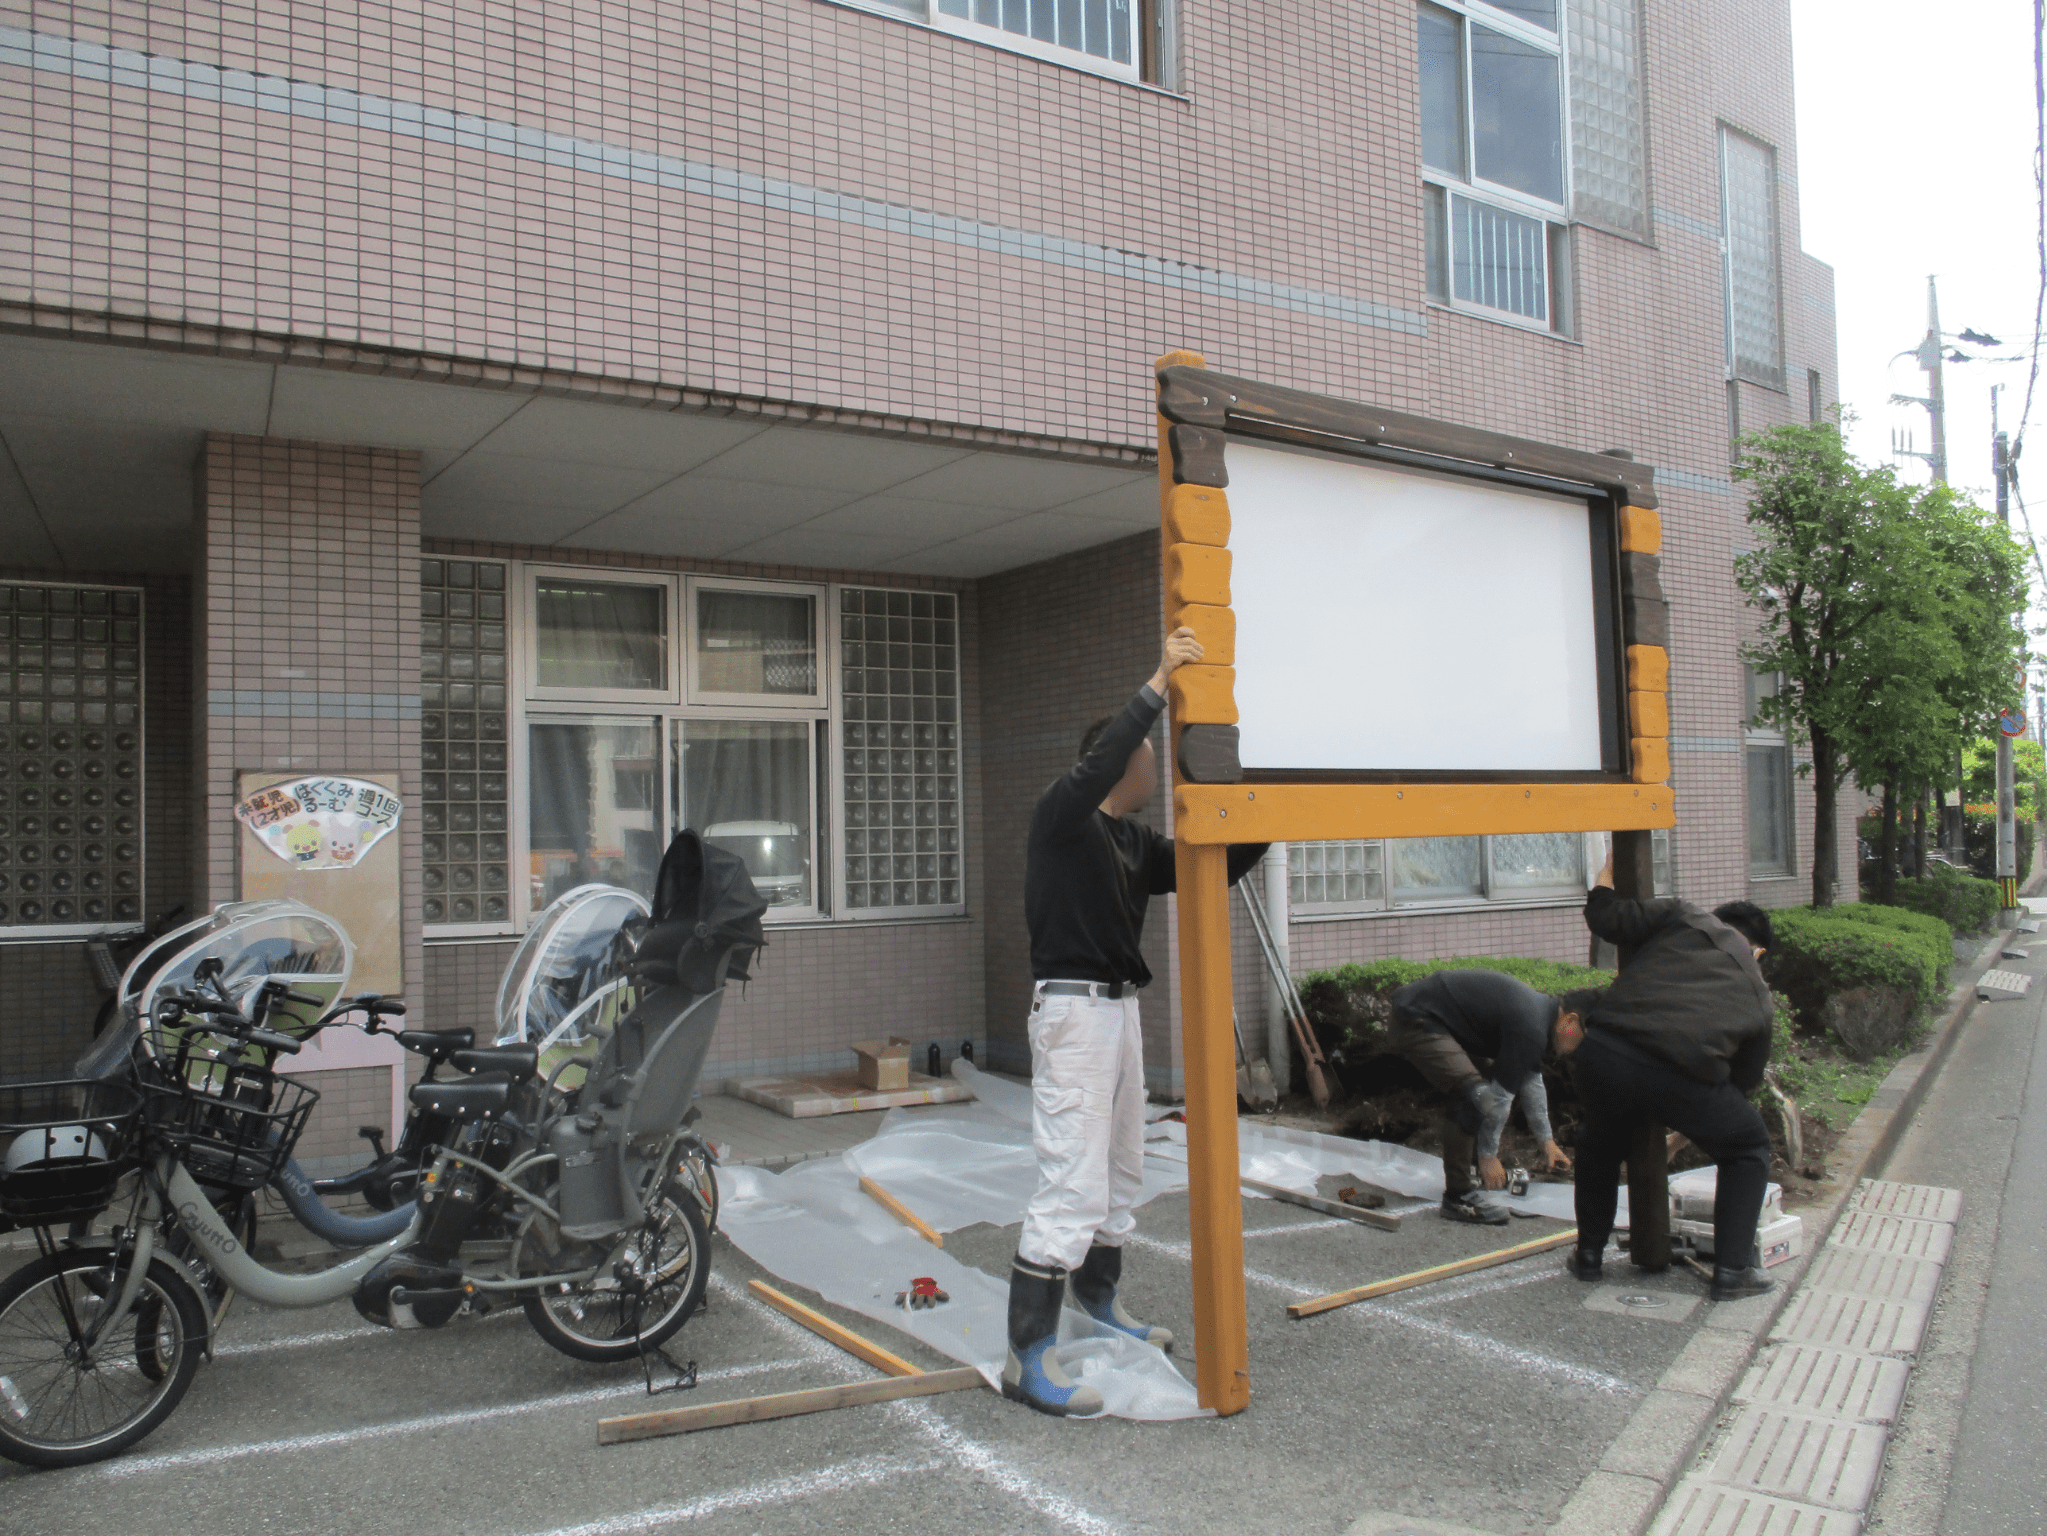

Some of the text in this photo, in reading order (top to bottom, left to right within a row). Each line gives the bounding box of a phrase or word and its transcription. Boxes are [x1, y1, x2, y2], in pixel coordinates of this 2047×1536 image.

[304, 798, 347, 813] るーむ
[356, 803, 392, 828] コース
